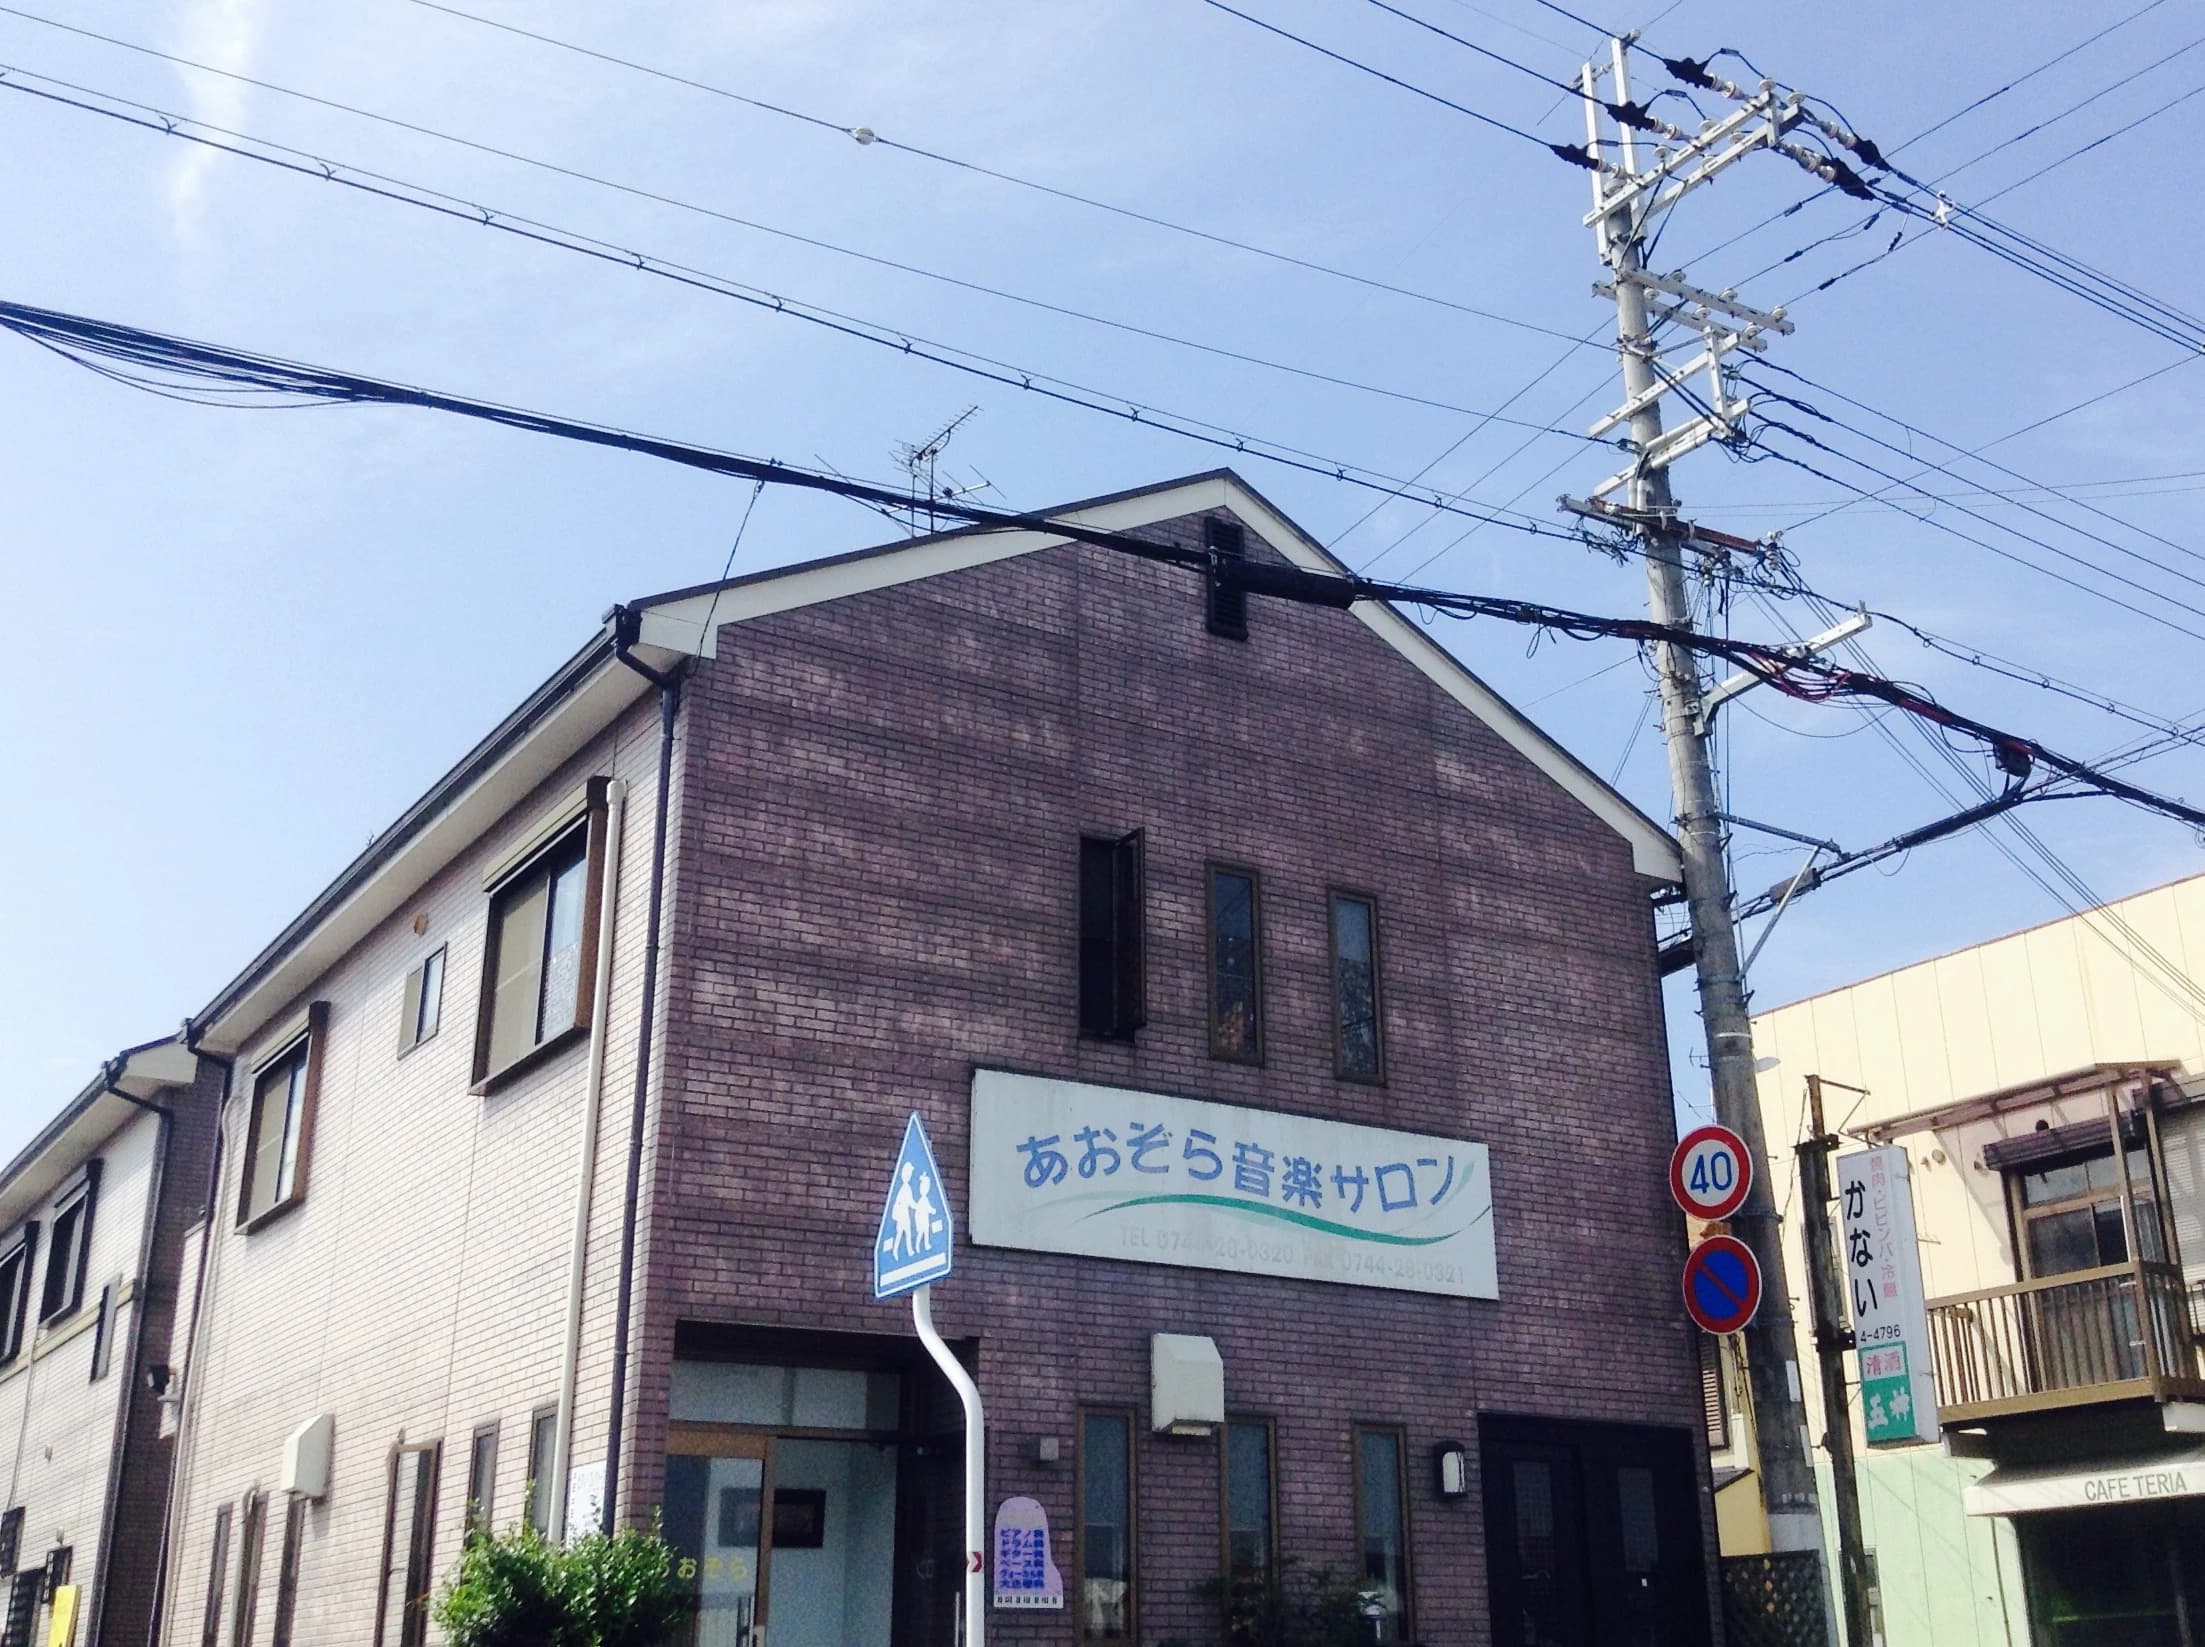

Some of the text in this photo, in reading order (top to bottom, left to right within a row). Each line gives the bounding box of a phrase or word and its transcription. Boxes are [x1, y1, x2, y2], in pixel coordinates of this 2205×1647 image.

[1016, 1121, 1455, 1213] あおぞら音楽サロン
[1690, 1151, 1732, 1193] 40
[1121, 1225, 1149, 1247] TEL
[1156, 1230, 1295, 1264] 07428-0320
[1844, 1179, 1878, 1318] かない
[1860, 1324, 1901, 1342] 4-4796
